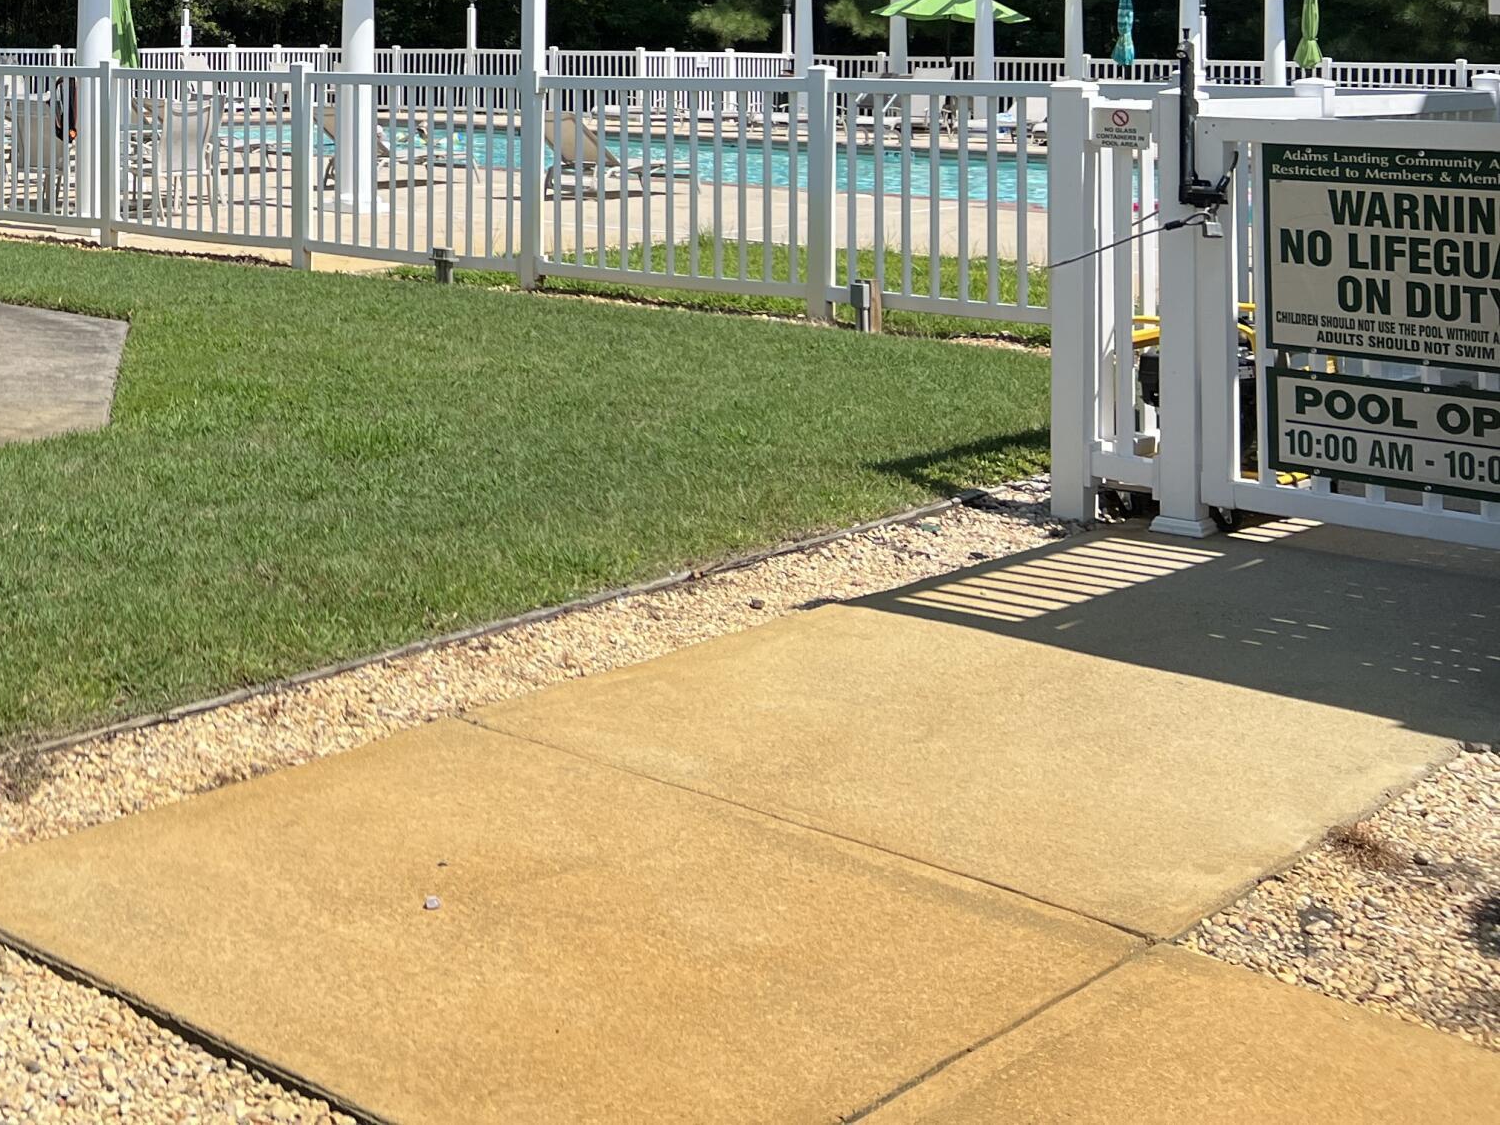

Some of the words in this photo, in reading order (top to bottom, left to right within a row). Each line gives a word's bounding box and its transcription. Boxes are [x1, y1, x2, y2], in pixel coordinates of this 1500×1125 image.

[1271, 164, 1339, 177] Restricted
[1346, 167, 1359, 178] to
[1365, 168, 1433, 182] Members
[1439, 172, 1452, 183] &
[1458, 173, 1500, 185] Mem
[1282, 150, 1328, 162] Adams
[1333, 152, 1389, 167] Landing
[1395, 154, 1482, 171] Community
[1327, 189, 1500, 235] WARNIN
[1280, 228, 1332, 267] NO
[1337, 275, 1391, 315] ON
[1276, 311, 1318, 326] CHILDREN
[1321, 315, 1356, 330] SHOULD
[1357, 319, 1375, 332] NOT
[1378, 321, 1395, 334] USE
[1399, 323, 1416, 337] THE
[1419, 325, 1443, 340] POOL
[1446, 327, 1489, 343] WITHOUT
[1316, 330, 1364, 346] ADULTS
[1368, 335, 1420, 352] SHOULD
[1424, 342, 1451, 356] NOT
[1455, 345, 1495, 360] SWIM
[1295, 385, 1418, 430] POOL
[1285, 428, 1357, 464] 10:00
[1368, 439, 1414, 472] AM
